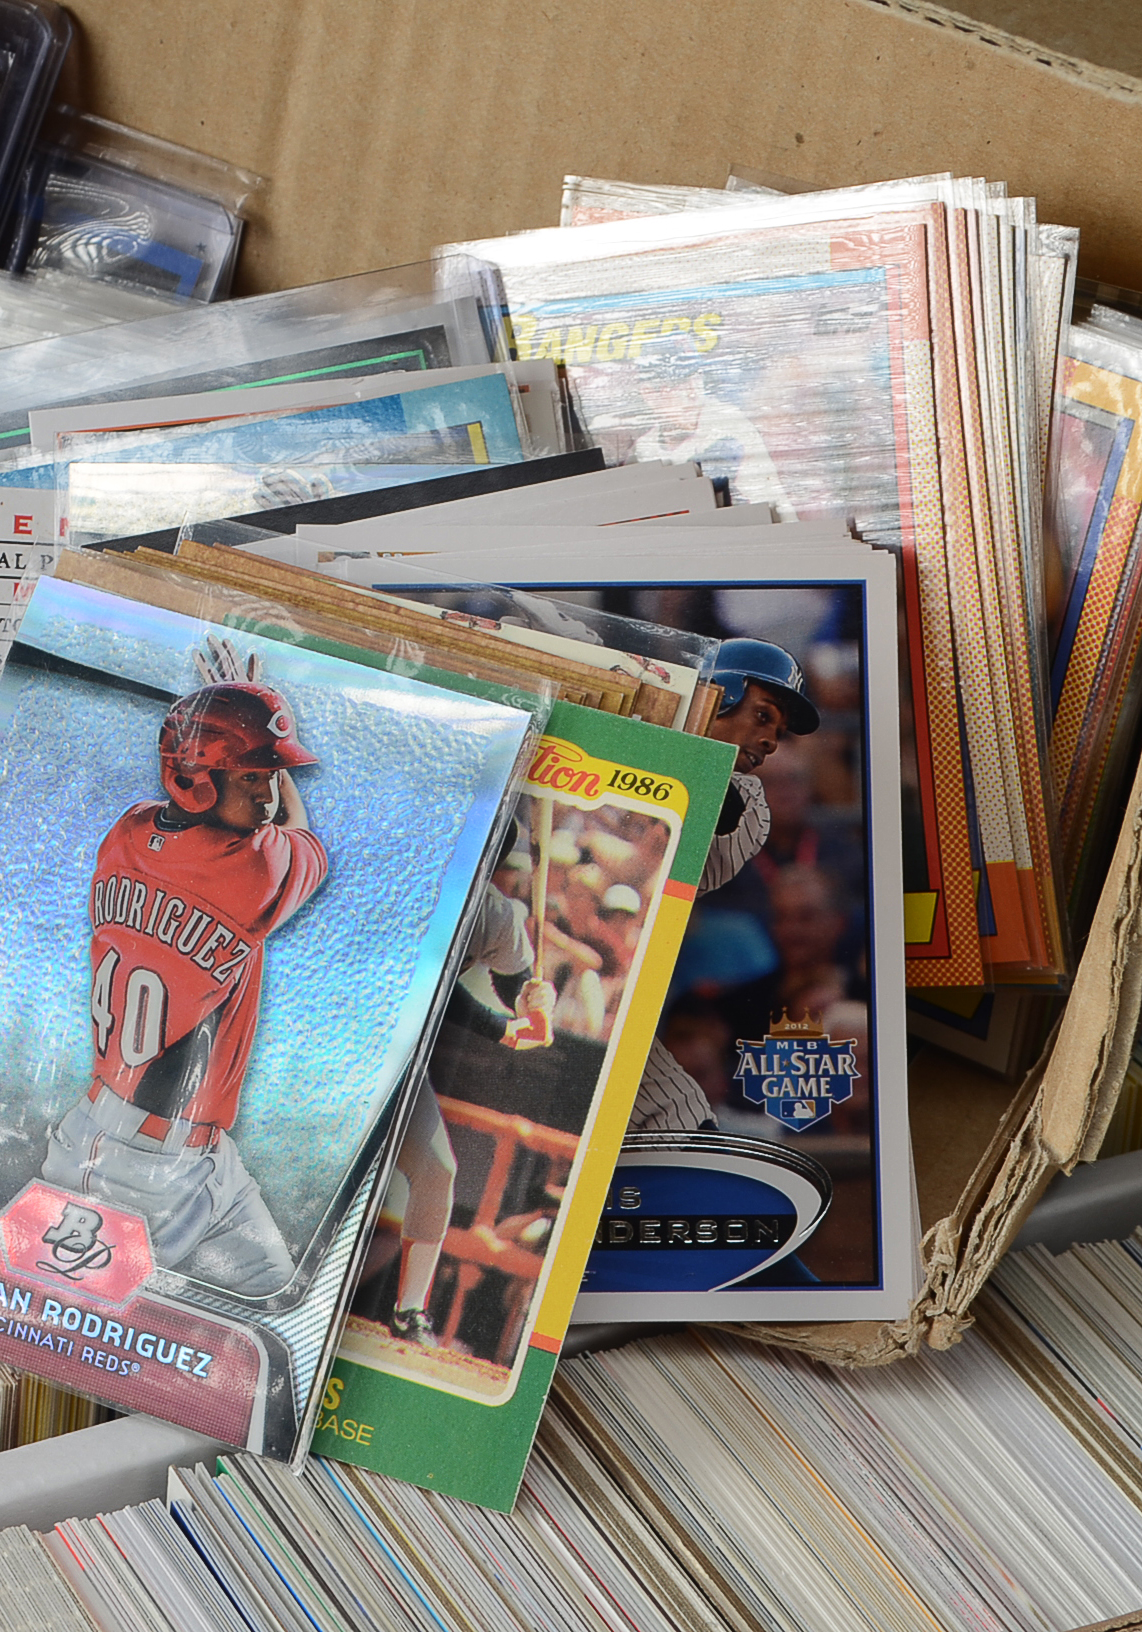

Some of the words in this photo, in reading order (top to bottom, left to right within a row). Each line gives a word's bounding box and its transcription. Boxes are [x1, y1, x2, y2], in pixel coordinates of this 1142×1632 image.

[606, 769, 674, 802] 1986
[94, 875, 253, 986] RODRIGUEZ
[91, 945, 170, 1069] 40
[784, 1023, 809, 1031] 2012
[776, 1041, 819, 1050] MLB
[761, 1077, 834, 1098] GAME
[40, 1298, 214, 1380] RODRIGUEZ
